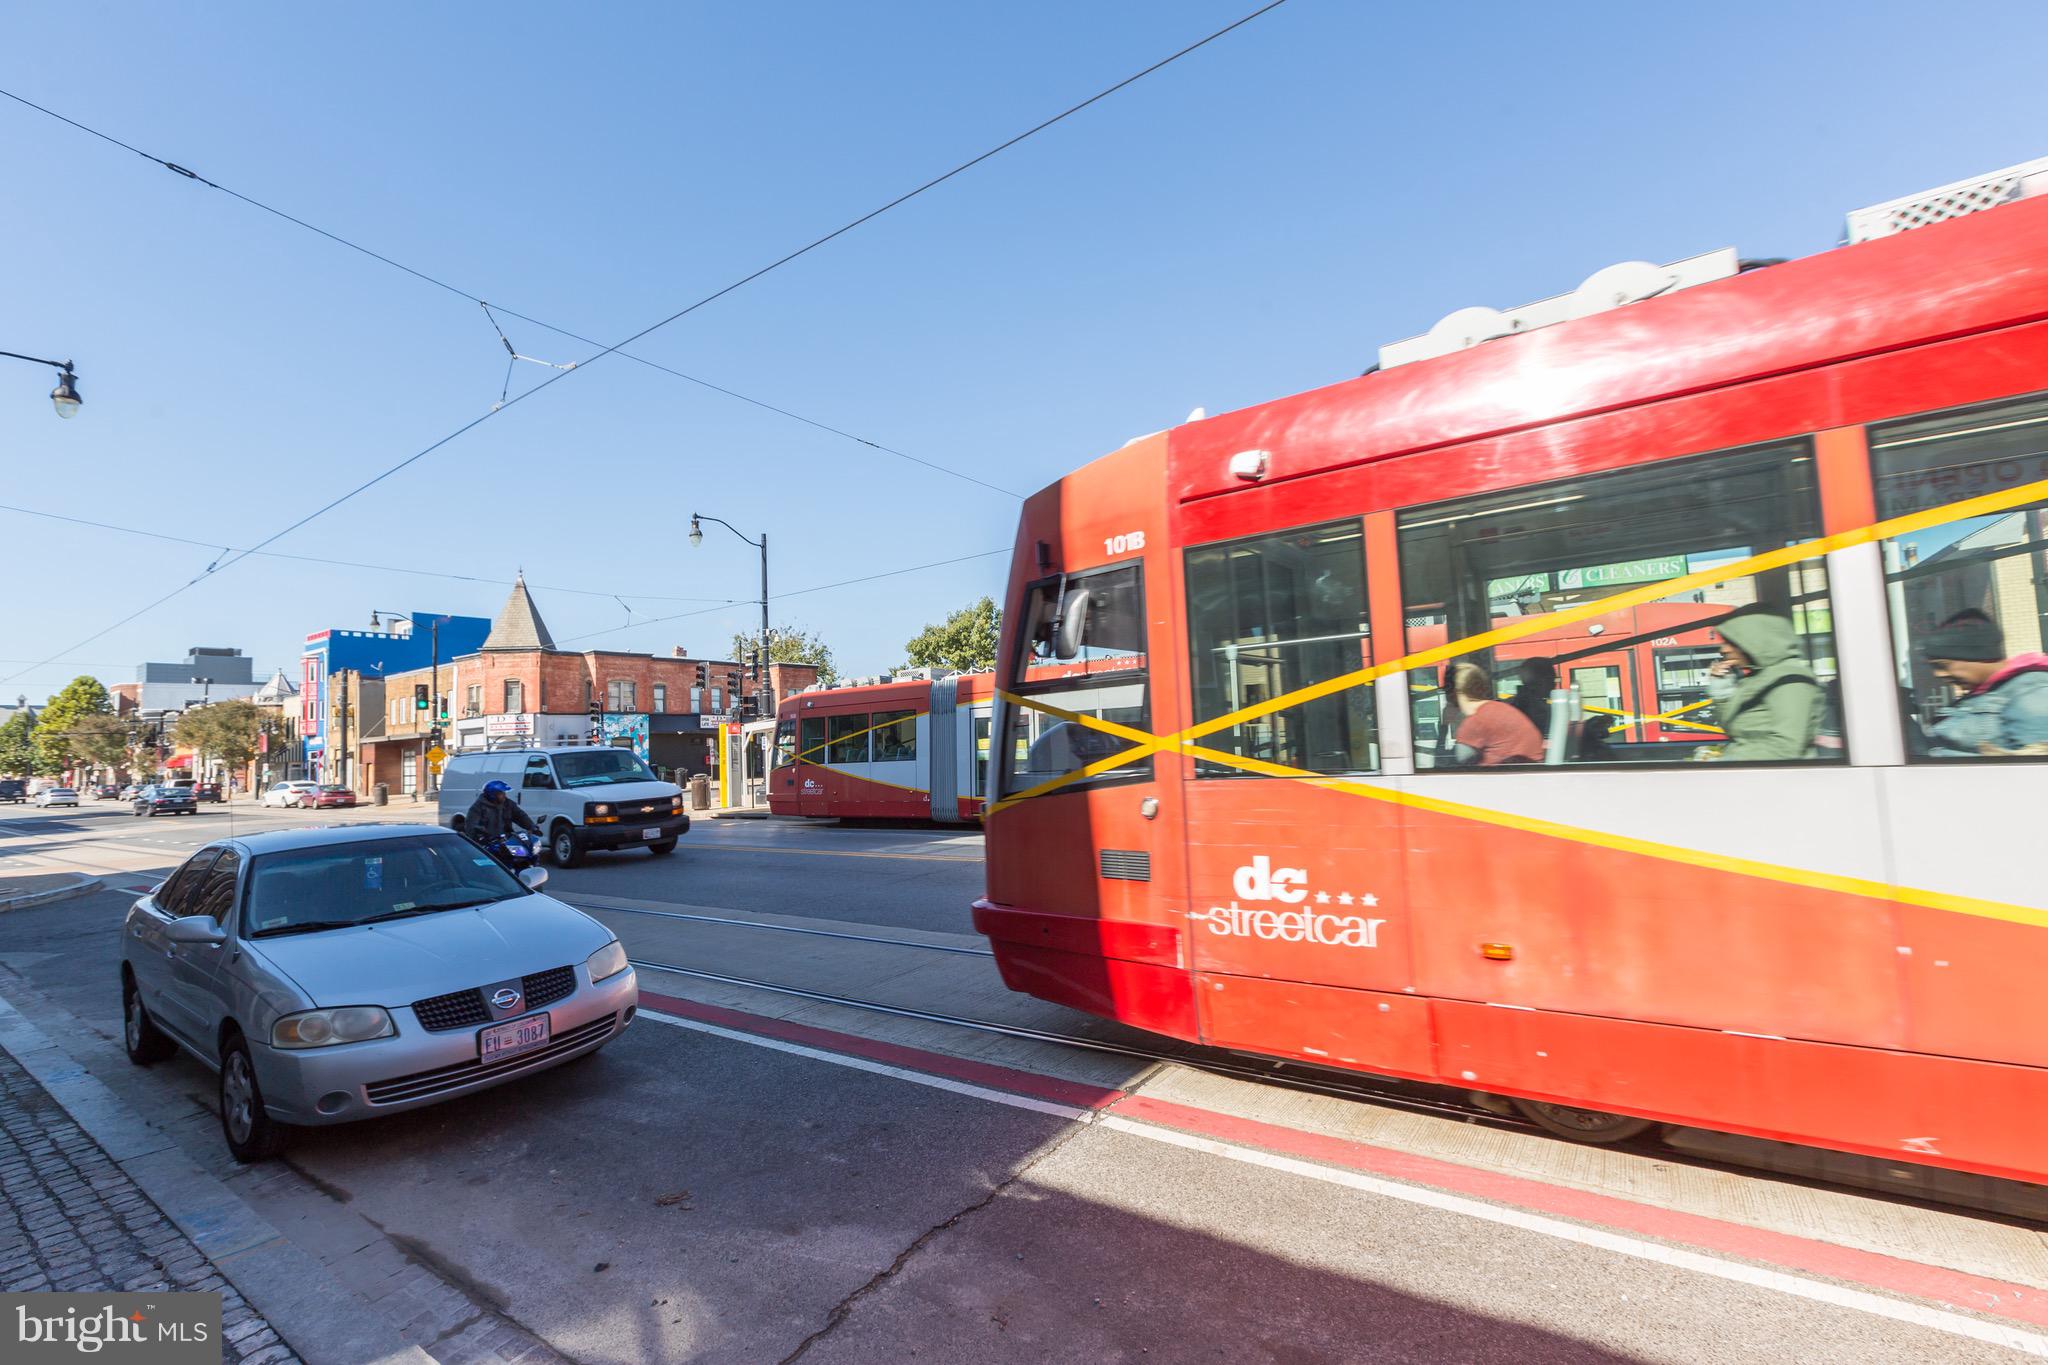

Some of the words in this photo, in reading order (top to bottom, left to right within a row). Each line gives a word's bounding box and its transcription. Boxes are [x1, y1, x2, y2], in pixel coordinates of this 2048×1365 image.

[1104, 531, 1146, 555] 101B
[1586, 561, 1680, 582] CLEANERS
[1496, 575, 1544, 595] ANERS
[1651, 637, 1678, 647] 102A
[804, 779, 815, 788] dc
[1233, 856, 1309, 903] dc
[1207, 901, 1387, 948] streetcar
[517, 1023, 544, 1045] 3087
